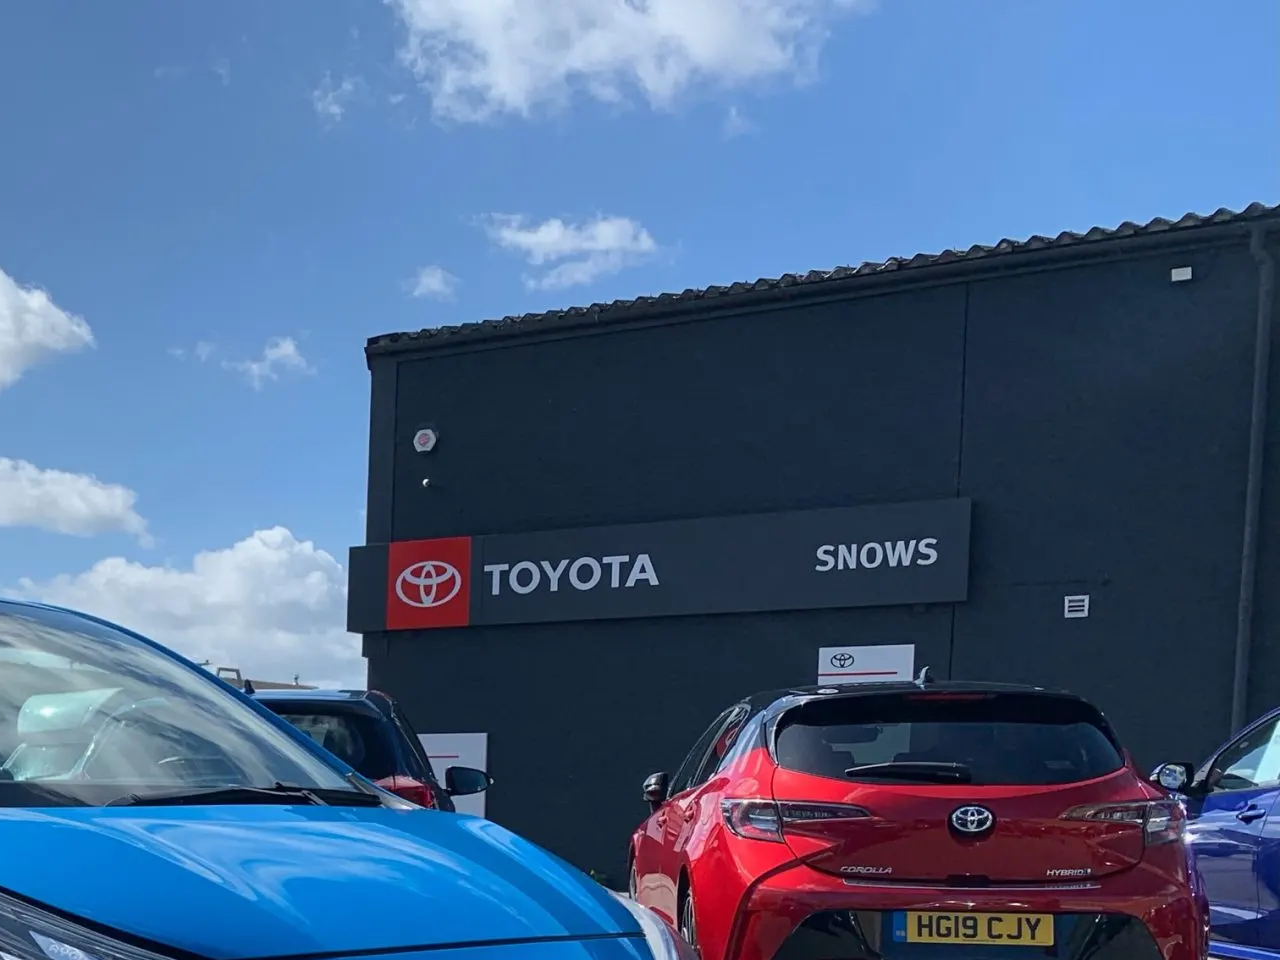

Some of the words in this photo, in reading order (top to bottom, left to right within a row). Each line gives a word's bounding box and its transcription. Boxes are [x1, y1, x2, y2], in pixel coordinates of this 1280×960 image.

[815, 537, 939, 572] SNOWS
[483, 553, 661, 596] TOYOTA
[840, 865, 893, 874] COROLLA
[1046, 868, 1085, 877] HYBRID
[917, 914, 979, 939] HG19
[987, 916, 1042, 941] CJY
